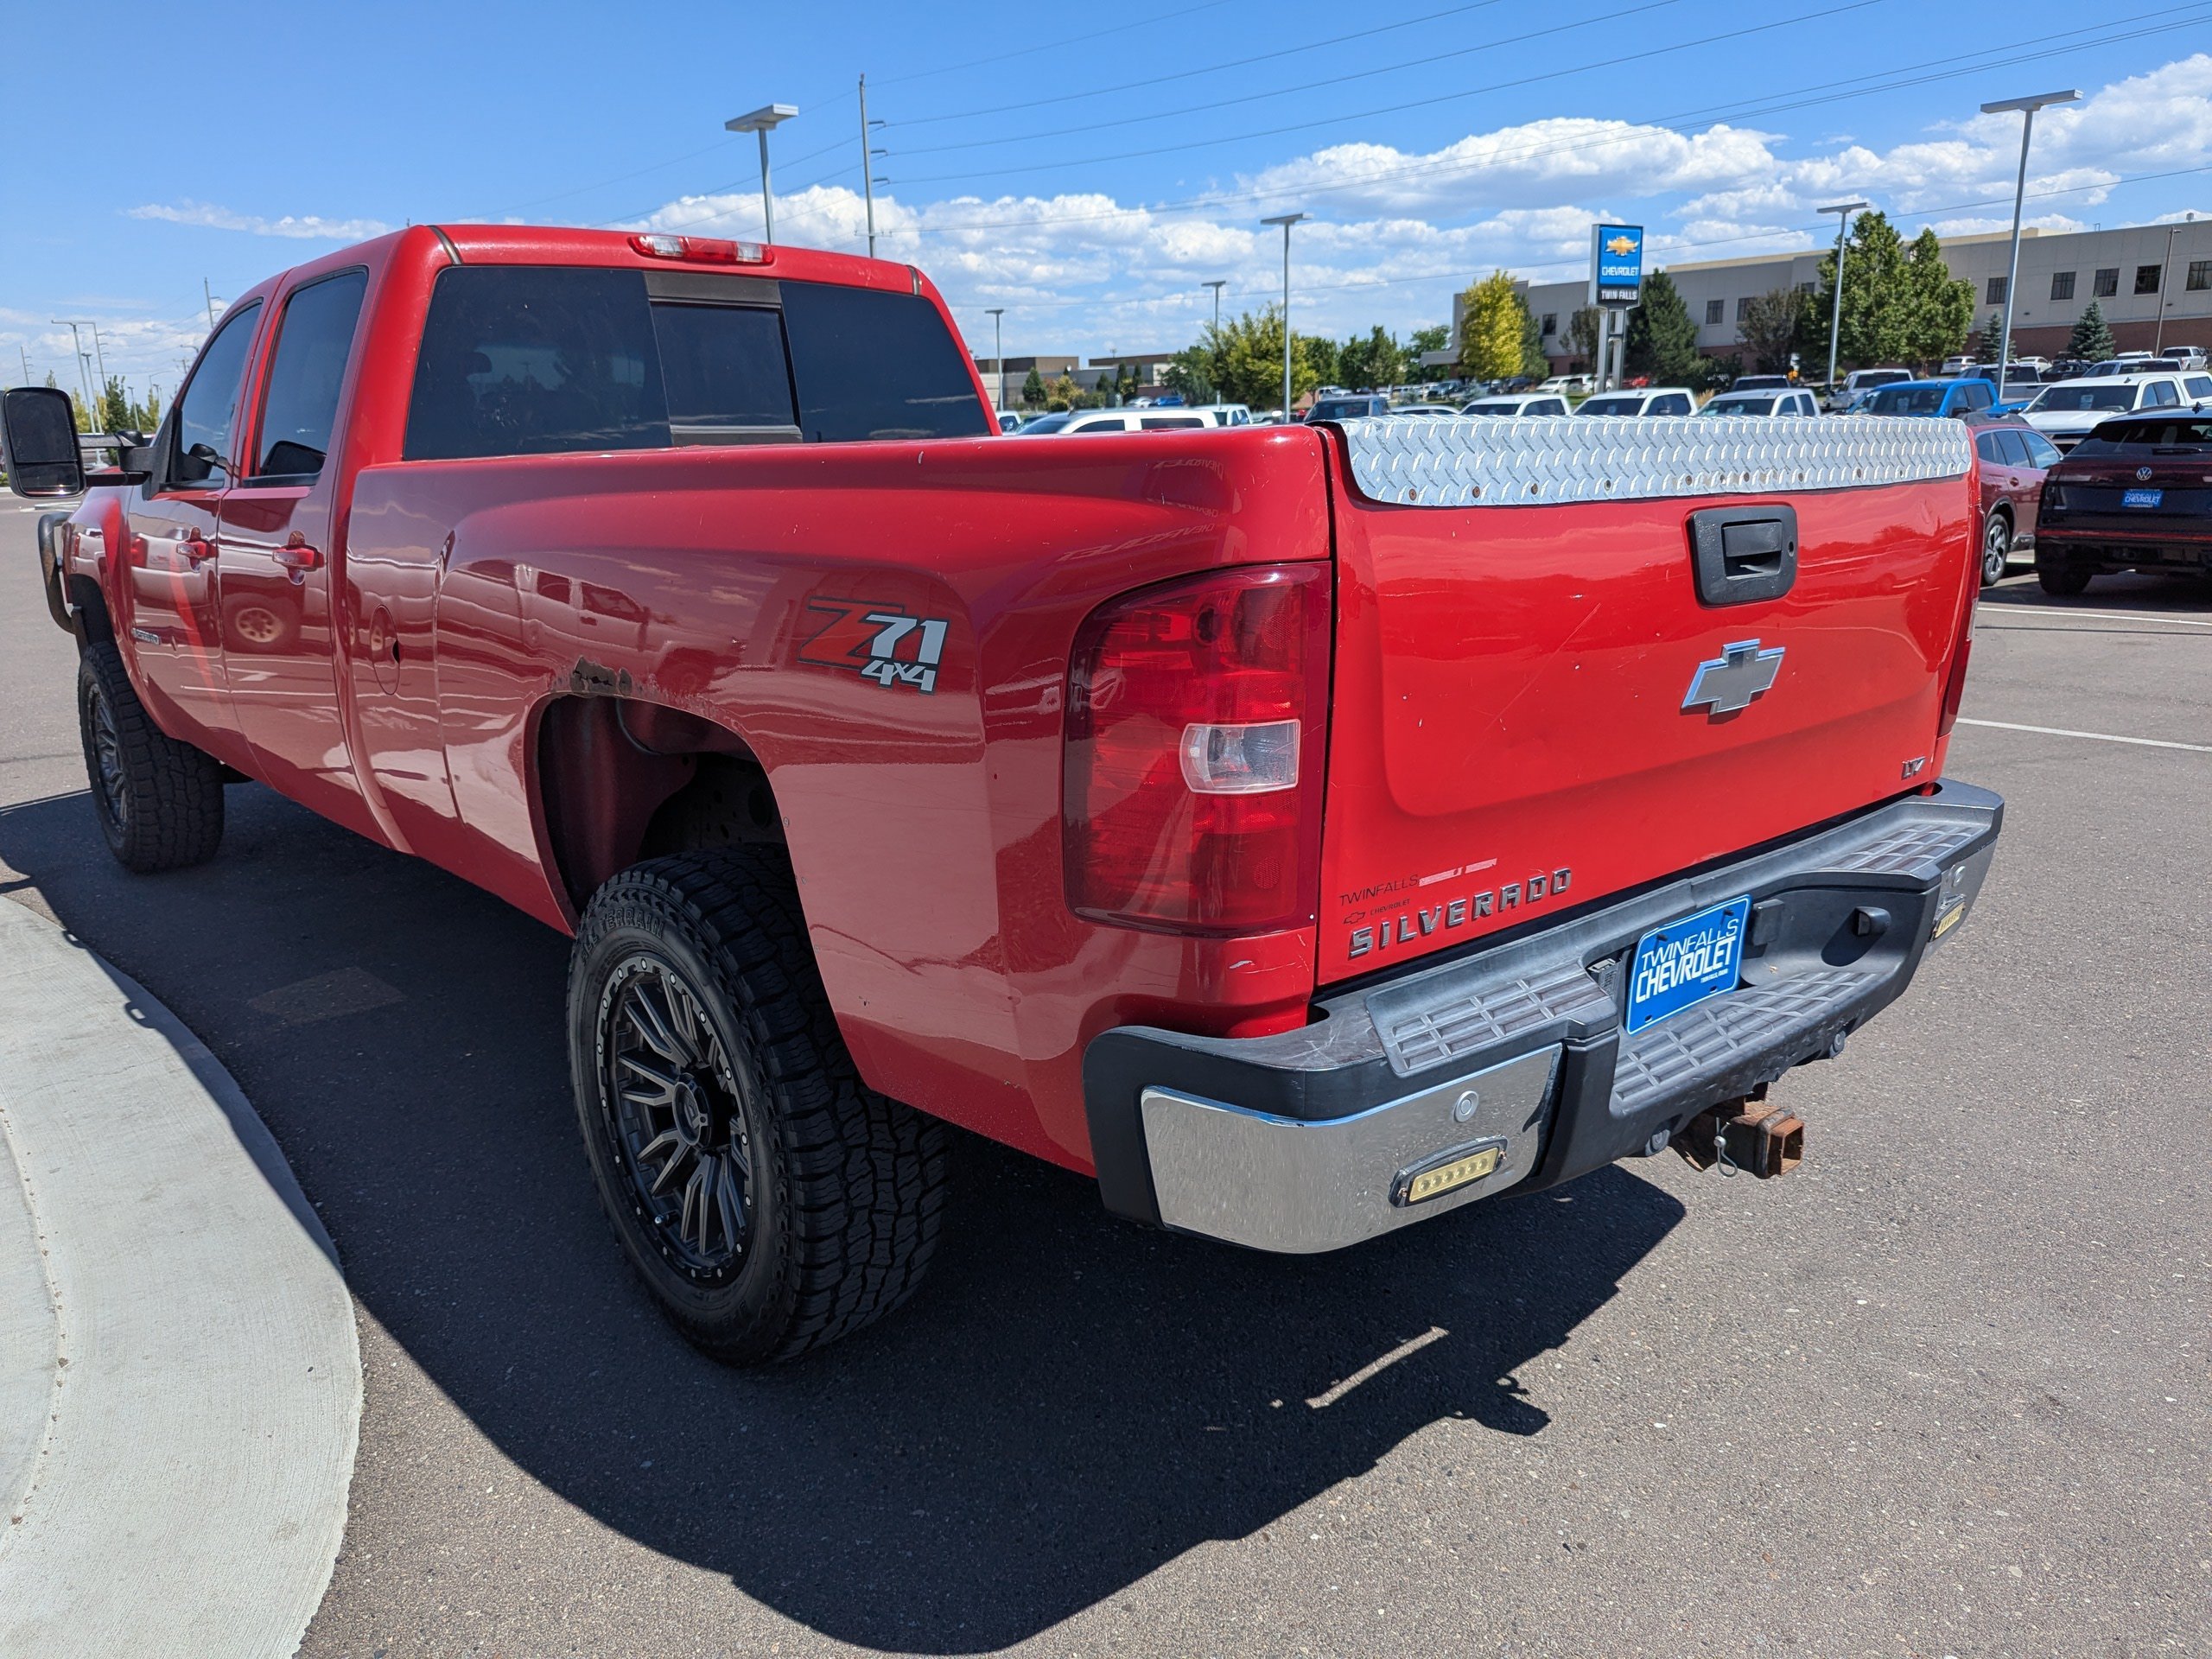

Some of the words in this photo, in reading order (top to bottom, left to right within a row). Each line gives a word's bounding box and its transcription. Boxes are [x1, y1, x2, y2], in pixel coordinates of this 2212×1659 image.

[1601, 266, 1638, 276] CHEVROLET
[1601, 290, 1618, 300] TWIN
[1618, 290, 1637, 300] FALLS
[798, 596, 950, 671] Z71
[1339, 874, 1418, 906] TWINFALLS
[1370, 899, 1410, 916] CHEVROLET
[1349, 868, 1571, 957] SILVERADO
[1642, 918, 1739, 970] TWINFALLS
[1636, 936, 1736, 1003] CHEVROLET
